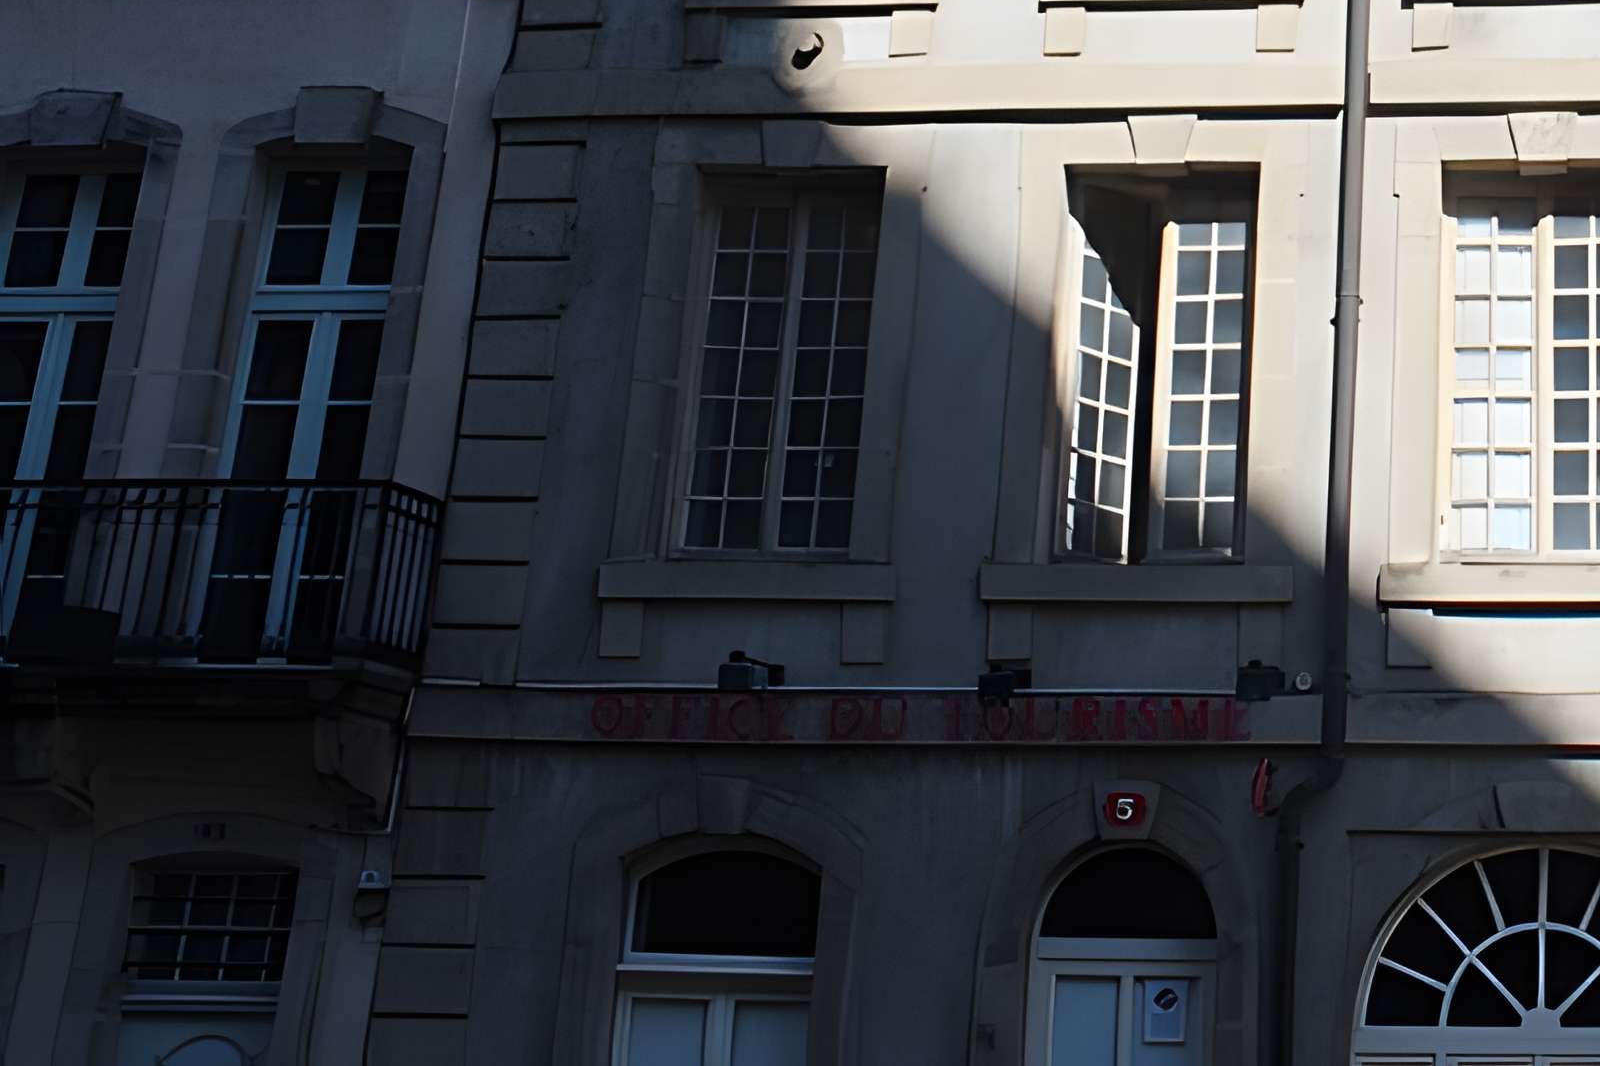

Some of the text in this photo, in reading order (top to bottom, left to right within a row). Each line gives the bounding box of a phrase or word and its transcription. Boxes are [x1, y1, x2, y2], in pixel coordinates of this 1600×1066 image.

[591, 692, 1250, 742] OFFICE DU TOURISME
[1115, 798, 1135, 820] 5
